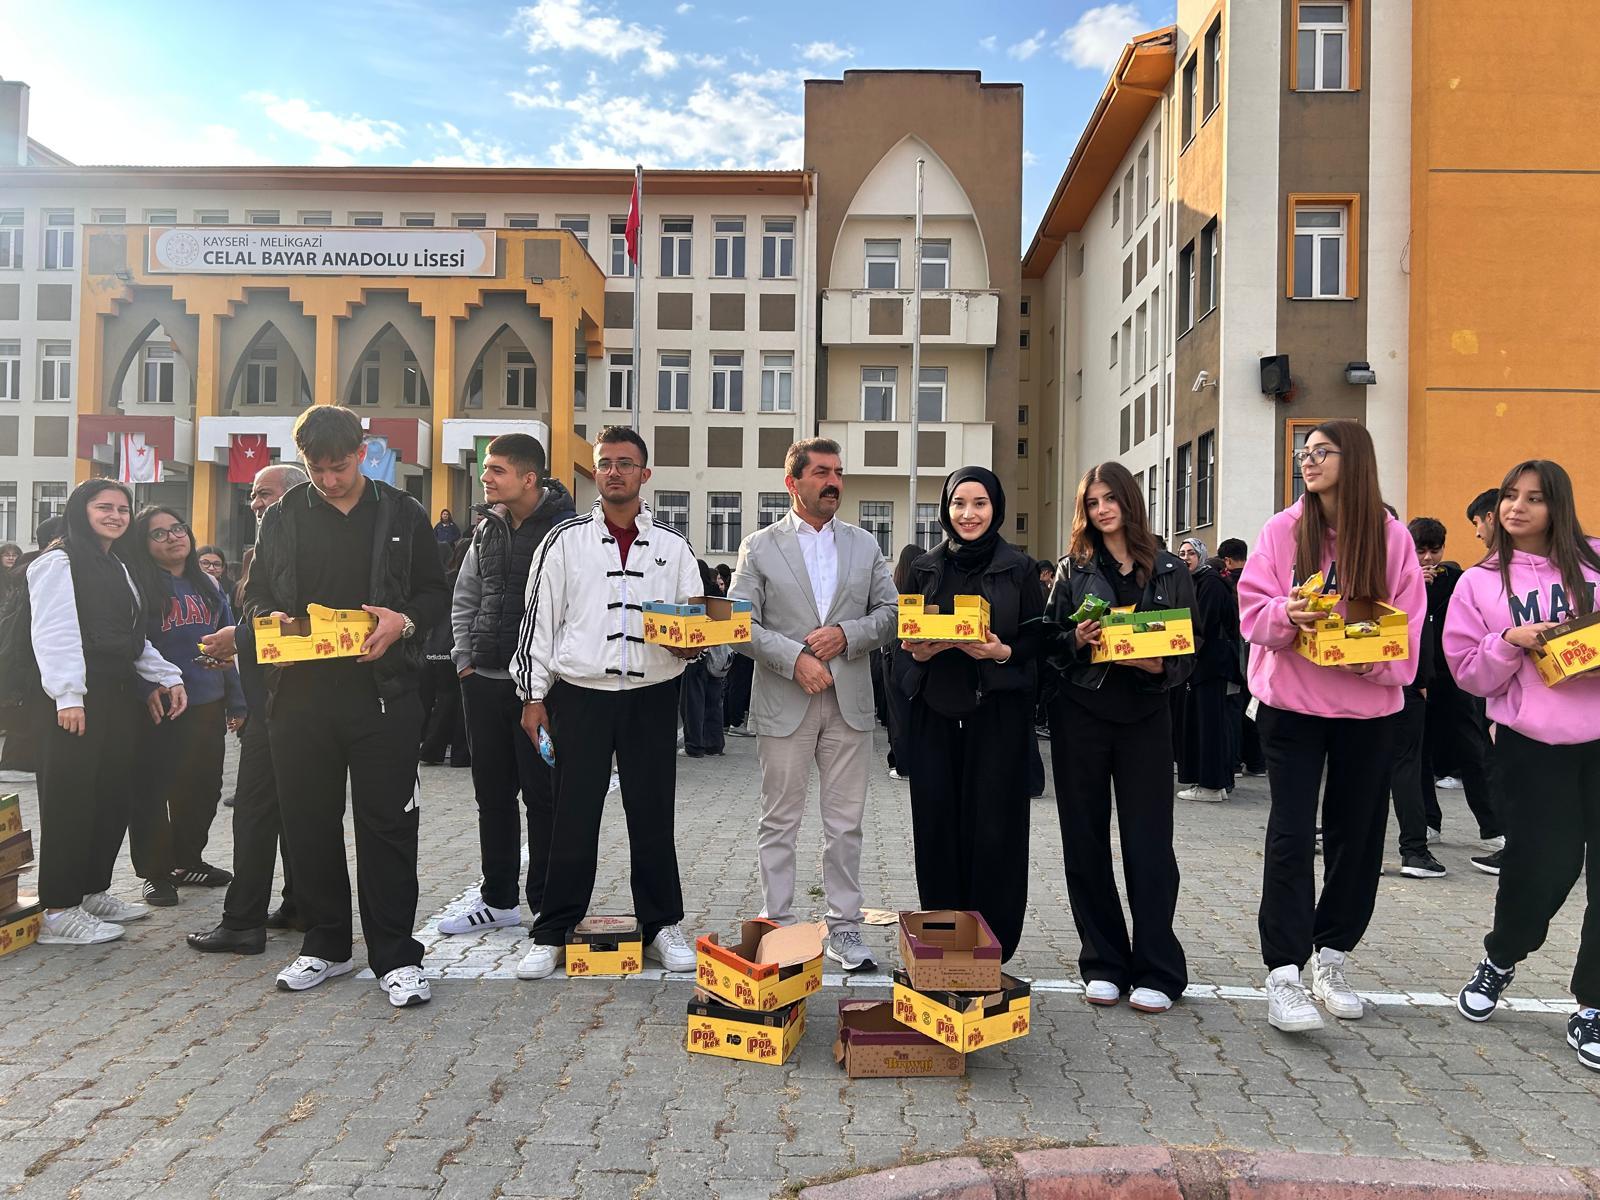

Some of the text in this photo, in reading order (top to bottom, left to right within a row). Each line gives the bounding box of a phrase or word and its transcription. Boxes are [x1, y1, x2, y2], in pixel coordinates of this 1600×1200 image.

[203, 234, 249, 247] KAYSERİ
[260, 235, 322, 247] MELİKGAZİ
[203, 249, 465, 267] CELAL BAYAR ANADOLU LİSESİ
